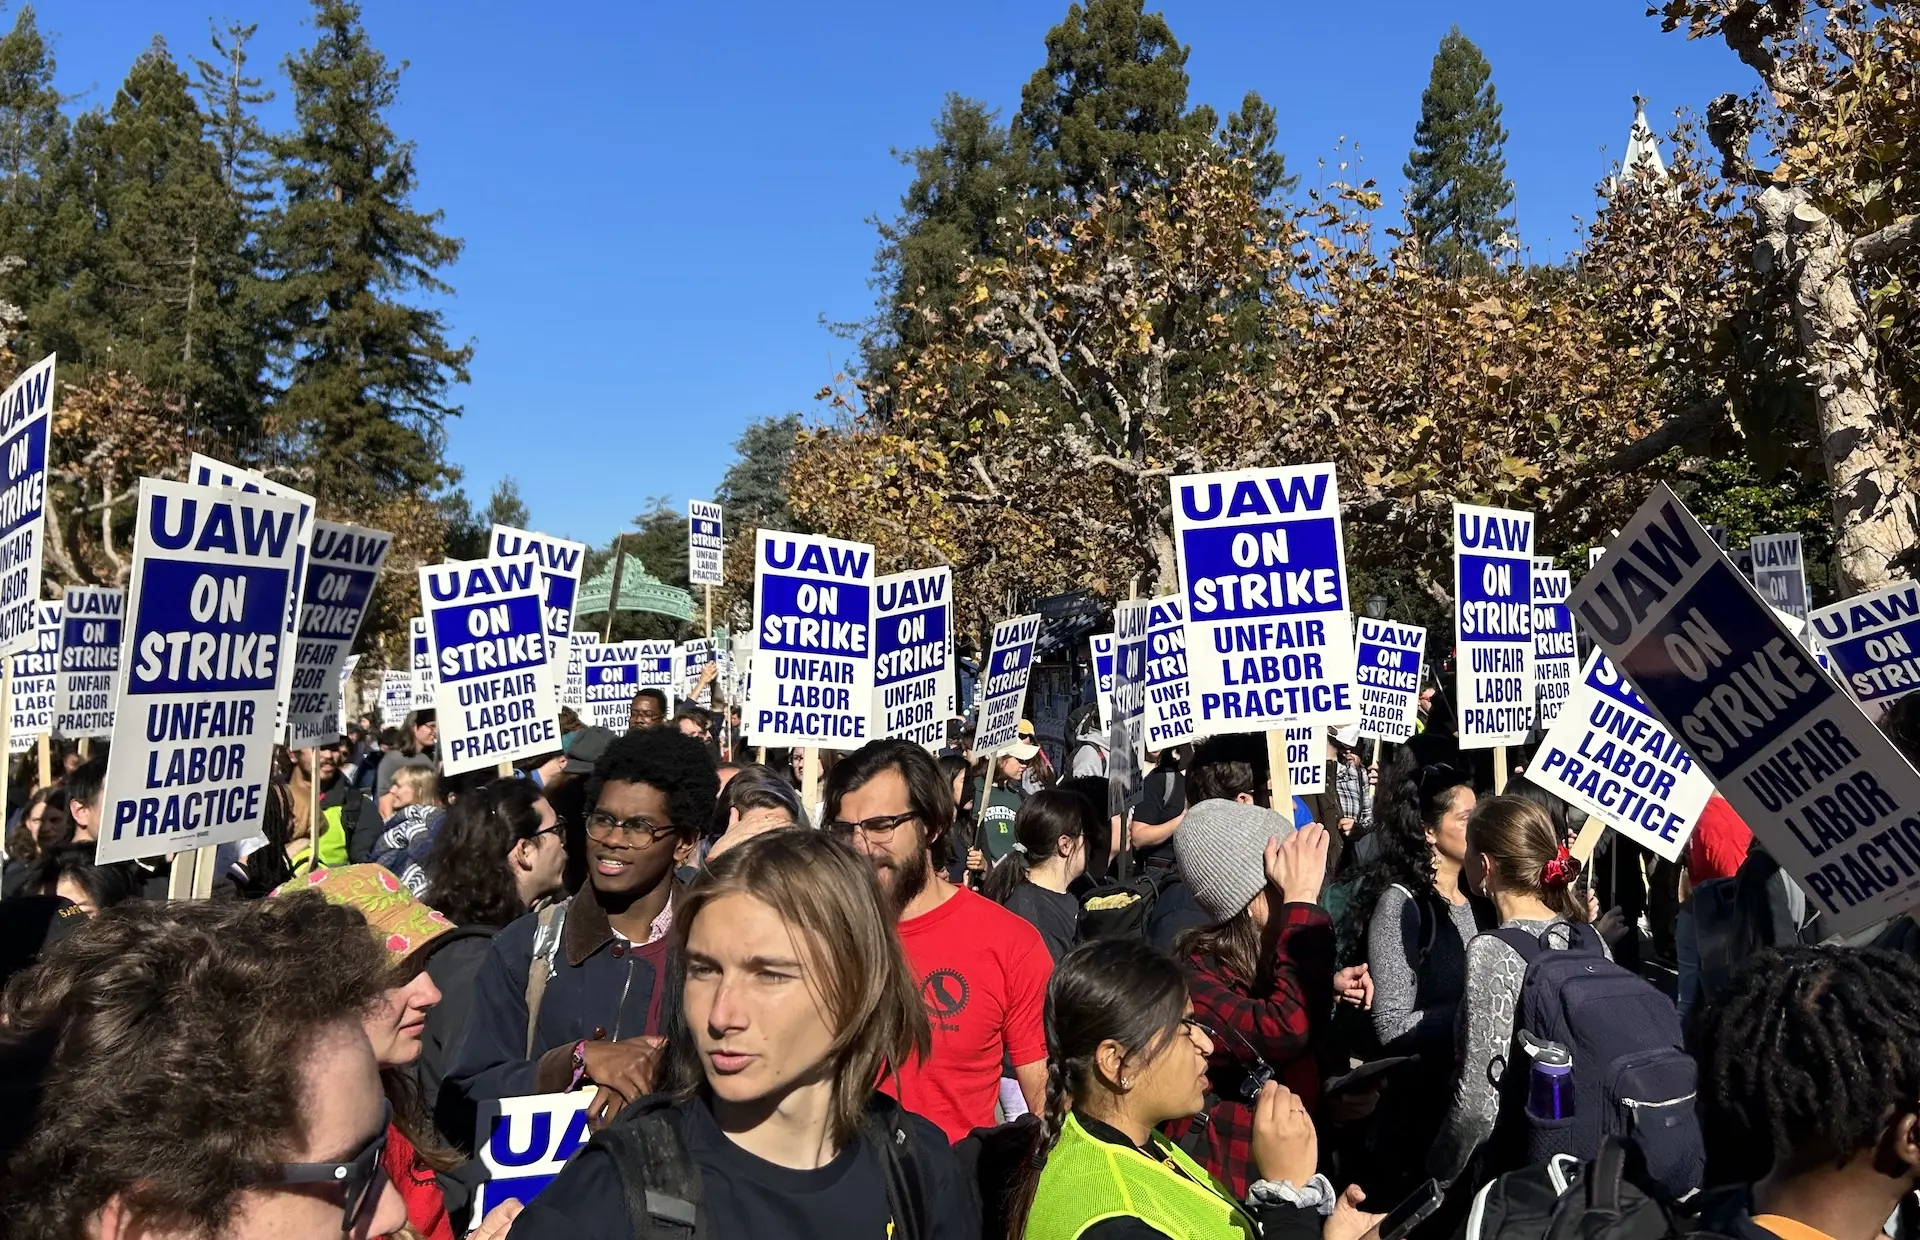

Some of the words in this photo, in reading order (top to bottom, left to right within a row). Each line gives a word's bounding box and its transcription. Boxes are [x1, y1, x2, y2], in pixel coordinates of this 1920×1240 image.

[9, 433, 29, 480] ON
[692, 504, 720, 519] UAW
[1181, 474, 1329, 521] UAW
[150, 495, 295, 558] UAW
[692, 533, 720, 549] STRIKE
[701, 521, 713, 534] ON
[1460, 513, 1530, 552] UAW
[0, 529, 32, 573] NFAIR
[310, 529, 388, 566] UAW
[496, 533, 580, 572] UAW
[696, 550, 718, 560] UNFAIR
[765, 539, 870, 579] UAW
[1232, 529, 1289, 568] ON
[1753, 539, 1798, 567] UAW
[692, 570, 721, 582] PRACTICE
[697, 561, 717, 571] LABOR
[1483, 563, 1511, 596] ON
[1576, 501, 1701, 647] UAW
[0, 567, 28, 608] ABOR
[318, 573, 351, 600] ON
[428, 561, 534, 602] UAW
[877, 574, 946, 611] UAW
[1194, 568, 1337, 613] STRIKE
[1534, 577, 1566, 598] AW
[1770, 576, 1788, 600] ON
[67, 592, 121, 614] UAW
[190, 574, 246, 623] ON
[796, 584, 838, 615] ON
[1811, 588, 1920, 639] UAW
[300, 604, 360, 635] TRIKE
[468, 604, 511, 638] ON
[763, 614, 866, 651] STRIKE
[898, 614, 925, 644] ON
[1119, 605, 1146, 639] UAW
[1462, 600, 1530, 635] STRIKE
[1534, 607, 1556, 630] ON
[82, 623, 105, 643] ON
[571, 636, 597, 646] AW
[995, 620, 1038, 647] UAW
[1213, 620, 1326, 653] UNFAIR
[1362, 623, 1422, 648] UAW
[1665, 608, 1732, 682] ON
[1865, 631, 1911, 662] ON
[62, 647, 117, 668] STRIKE
[136, 632, 276, 681] STRIKE
[441, 633, 543, 676] STRIKE
[585, 647, 638, 663] UAW
[641, 644, 671, 655] AW
[876, 641, 944, 680] STRIKE
[1003, 649, 1021, 671] ON
[1127, 648, 1139, 679] ON
[1377, 649, 1402, 668] ON
[1472, 648, 1524, 672] UNFAIR
[68, 676, 110, 692] UNFAIR
[601, 667, 623, 683] ON
[775, 657, 854, 684] UNFAIR
[987, 667, 1027, 695] STRIKE
[1223, 653, 1324, 686] LABOR
[1357, 665, 1417, 689] STRIKE
[1535, 662, 1570, 680] NFAIR
[1852, 657, 1920, 695] STRI
[12, 679, 55, 694] UNFA
[458, 673, 536, 706] UNFAIR
[586, 683, 638, 700] STRIKE
[778, 684, 849, 710] LABOR
[885, 677, 936, 709] UNFAIR
[1116, 680, 1144, 714] STRIKE
[1201, 683, 1351, 720] PRACTICE
[1362, 689, 1407, 707] UNFAIR
[1476, 678, 1522, 703] LABOR
[1540, 682, 1570, 700] ABOR
[1681, 637, 1816, 762] STRIKE
[69, 694, 107, 711] LABOR
[465, 699, 536, 731] LABOR
[887, 701, 933, 732] LABOR
[988, 694, 1018, 716] UNFAIR
[1158, 700, 1191, 721] LAB
[1362, 704, 1403, 721] LABOR
[57, 712, 114, 730] PRACTICE
[146, 700, 256, 743] UNFAIR
[758, 710, 865, 738] PRACTICE
[986, 711, 1014, 732] LABOR
[1150, 718, 1194, 742] PRAC
[1286, 727, 1312, 741] AIR
[1360, 718, 1412, 737] RACTICE
[1465, 707, 1532, 734] PRACTICE
[451, 719, 555, 761] PRACTICE
[976, 724, 1018, 751] PRACTICE
[146, 744, 246, 789] LABOR
[1577, 731, 1676, 801] LABOR
[1743, 718, 1862, 813] UNFAIR
[1541, 748, 1685, 844] PRACTICE
[112, 784, 261, 840] PRACTICE
[1785, 770, 1900, 858] LABOR
